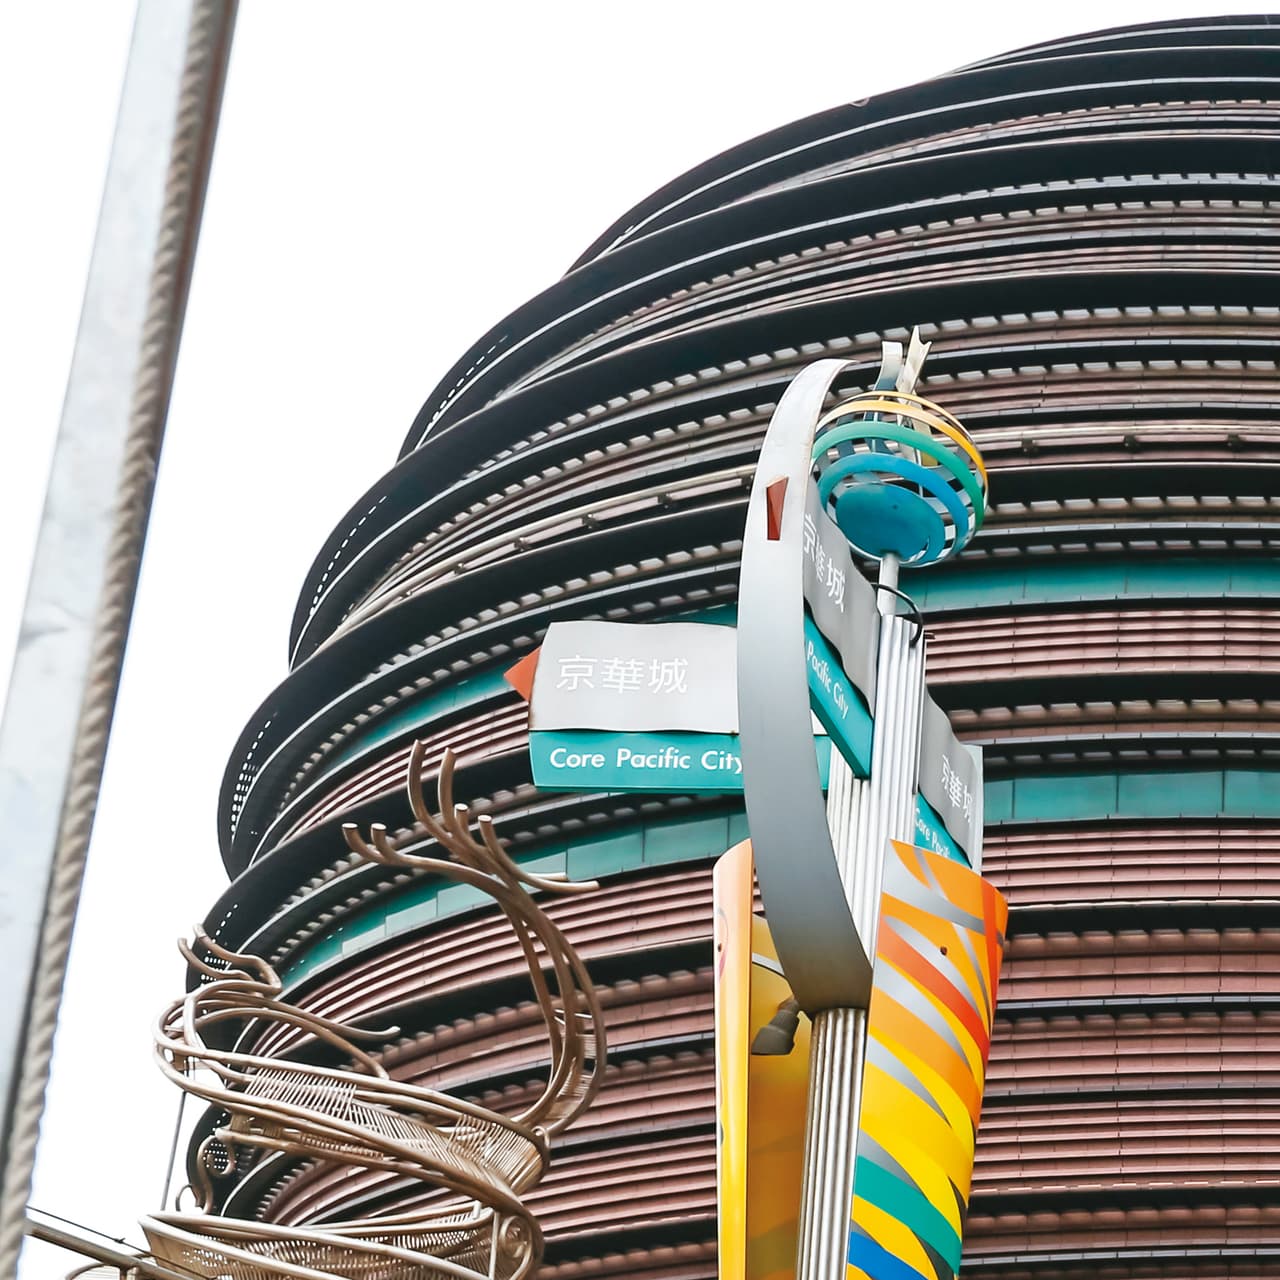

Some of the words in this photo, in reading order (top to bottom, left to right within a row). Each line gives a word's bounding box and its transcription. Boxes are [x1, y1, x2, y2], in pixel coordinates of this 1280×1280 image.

[804, 513, 846, 614] 京華城
[556, 655, 688, 693] 京華城
[807, 640, 831, 693] Pacific
[833, 682, 849, 720] City
[550, 748, 605, 768] Core
[616, 747, 691, 769] Pacific
[701, 751, 743, 774] City
